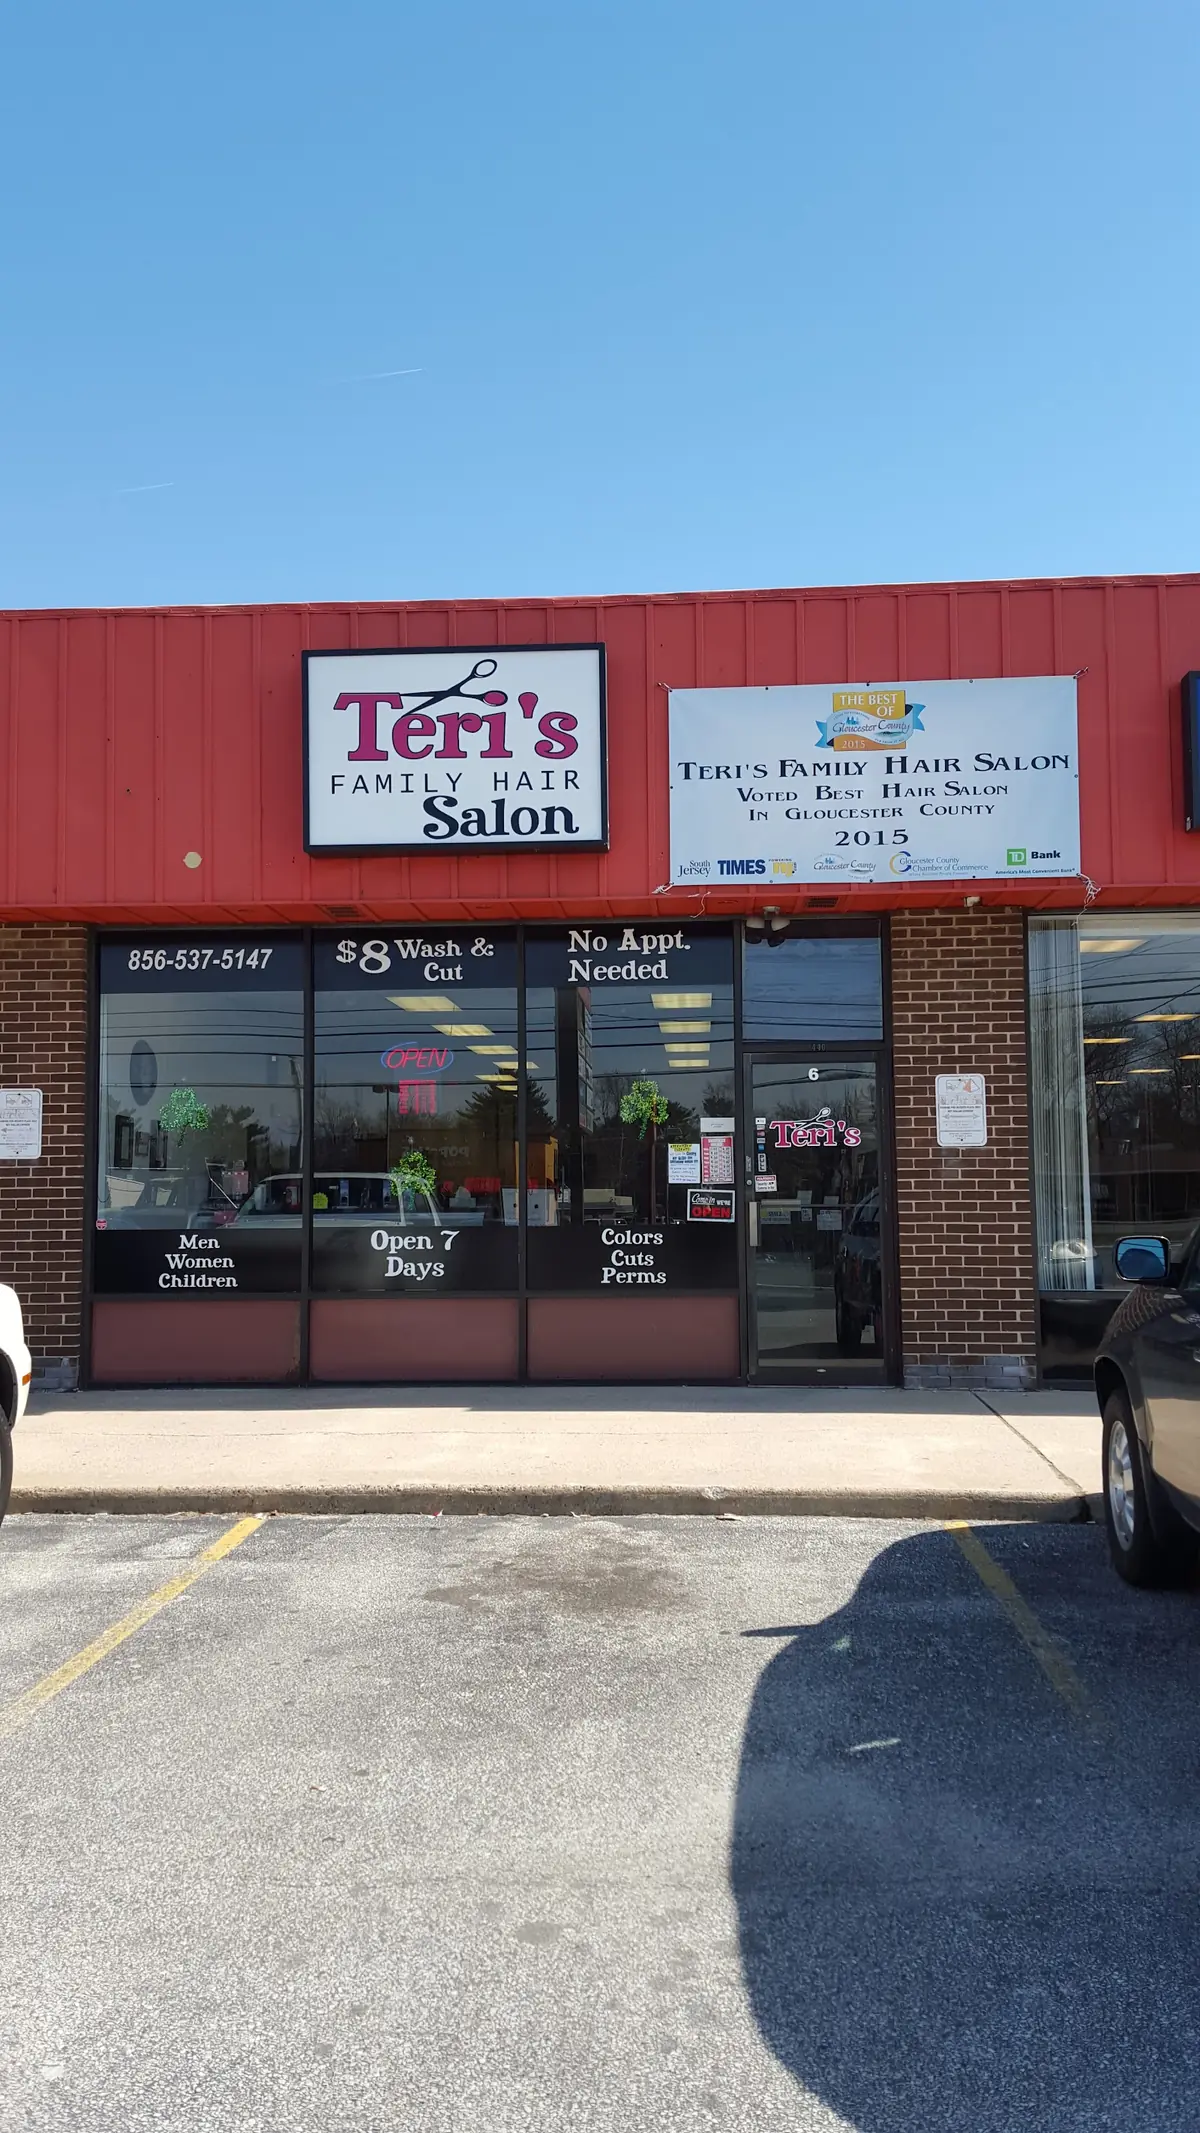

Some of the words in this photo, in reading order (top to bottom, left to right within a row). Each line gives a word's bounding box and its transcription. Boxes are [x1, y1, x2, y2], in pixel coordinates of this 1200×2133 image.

[839, 694, 864, 706] THE
[868, 692, 898, 706] BEST
[876, 705, 895, 717] OF
[333, 690, 579, 761] Teri's
[832, 721, 877, 733] Gloucester
[877, 719, 910, 735] County
[841, 739, 866, 749] 2015
[884, 755, 962, 775] HAIR
[973, 752, 1070, 772] SALON
[331, 773, 463, 794] FAMILY
[493, 770, 580, 792] HAIR
[814, 785, 864, 801] BEST
[882, 783, 936, 799] HAIR
[943, 780, 1008, 797] SALON
[422, 795, 580, 840] Salon
[785, 807, 904, 821] GLOUCESTER
[919, 804, 995, 816] COUNTY
[834, 829, 909, 846] 2015
[689, 859, 711, 868] South
[899, 857, 934, 866] Gloucester
[935, 857, 960, 866] County
[1008, 851, 1025, 863] TD
[1031, 850, 1061, 859] Bank
[677, 865, 711, 878] Jersey
[717, 859, 766, 876] TIMES
[394, 939, 463, 959] Wash
[470, 937, 494, 957] &
[567, 930, 608, 953] No
[617, 928, 692, 955] Appt.
[128, 949, 272, 971] 856-537-5147
[423, 962, 464, 982] Cut
[567, 959, 669, 982] Needed
[386, 1047, 448, 1069] OPEN
[808, 1067, 820, 1081] 6
[769, 1120, 862, 1148] Teri's
[691, 1206, 731, 1218] OPEN
[178, 1235, 220, 1249] Men
[370, 1230, 433, 1253] Open
[440, 1230, 459, 1250] 7
[601, 1228, 663, 1246] Colors
[165, 1253, 235, 1269] Women
[610, 1251, 654, 1267] Cuts
[385, 1257, 445, 1280] Days
[600, 1268, 667, 1285] Perms
[158, 1274, 238, 1289] Children
